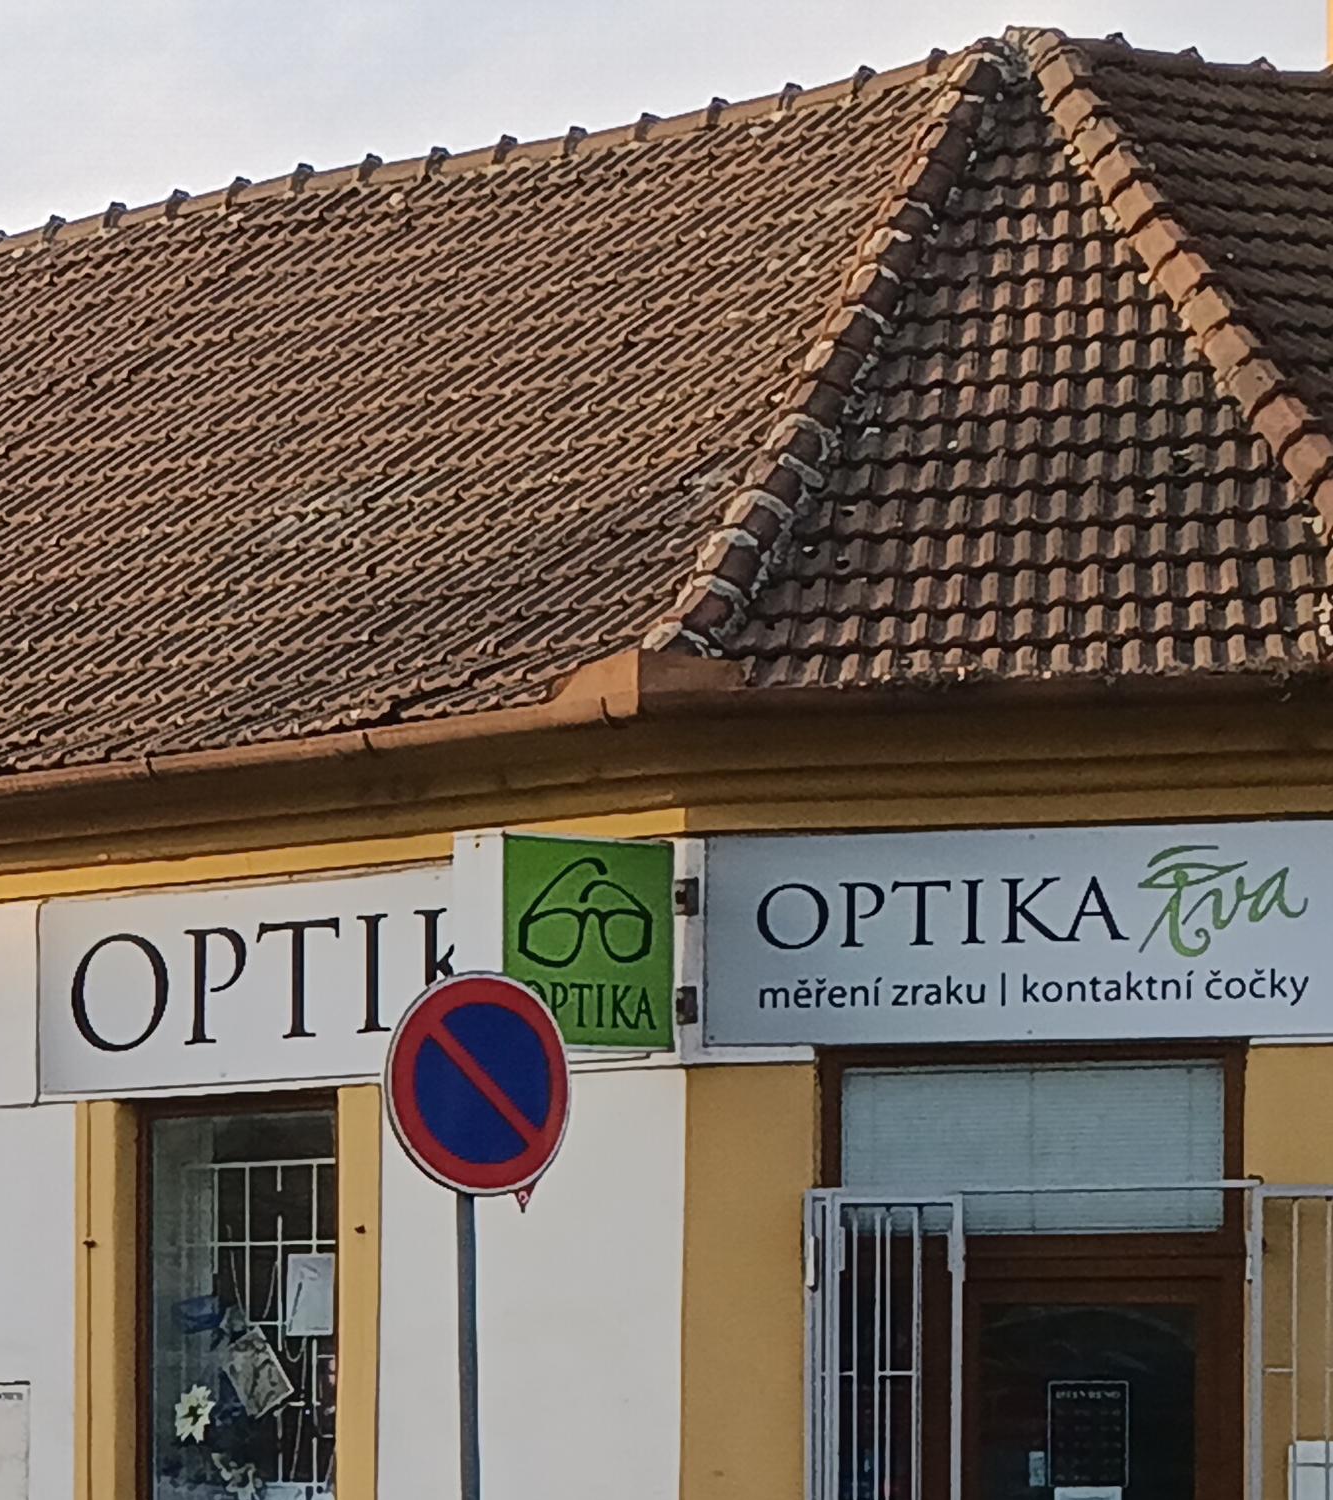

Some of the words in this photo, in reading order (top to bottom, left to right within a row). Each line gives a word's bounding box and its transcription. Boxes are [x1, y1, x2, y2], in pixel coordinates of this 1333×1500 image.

[756, 875, 1130, 950] OPTIKA
[758, 976, 881, 1010] měření
[891, 975, 986, 1007] zraku
[1022, 969, 1193, 1004] kontaktní
[1204, 968, 1309, 1007] čočky
